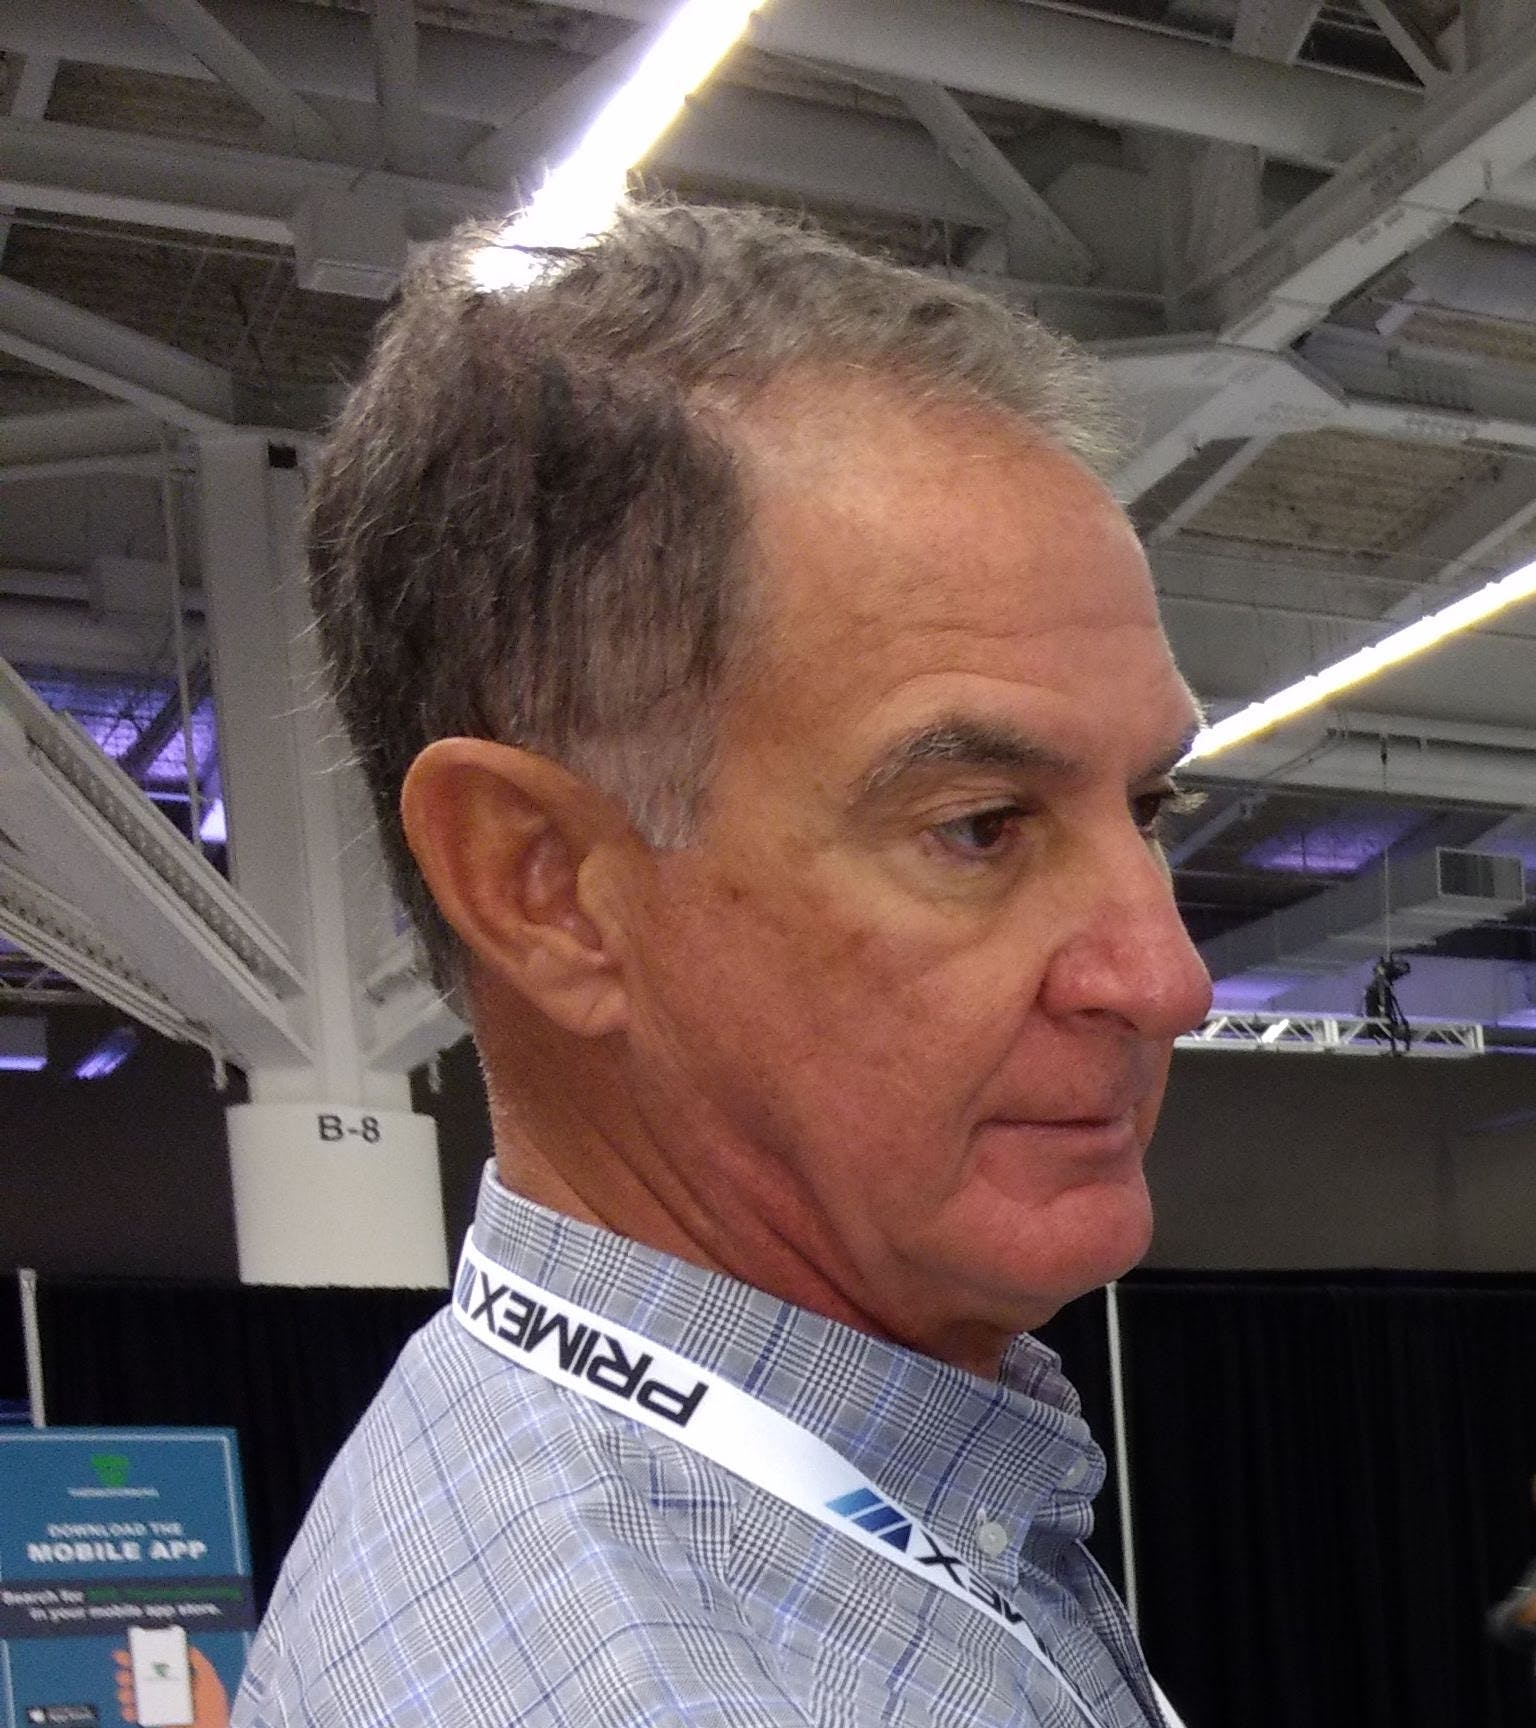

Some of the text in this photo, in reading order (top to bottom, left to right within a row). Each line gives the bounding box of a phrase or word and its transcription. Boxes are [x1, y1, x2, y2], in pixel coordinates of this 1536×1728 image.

[317, 1114, 382, 1144] B-8
[471, 1270, 709, 1428] PRIMEX
[26, 1539, 208, 1563] MOBILE APP
